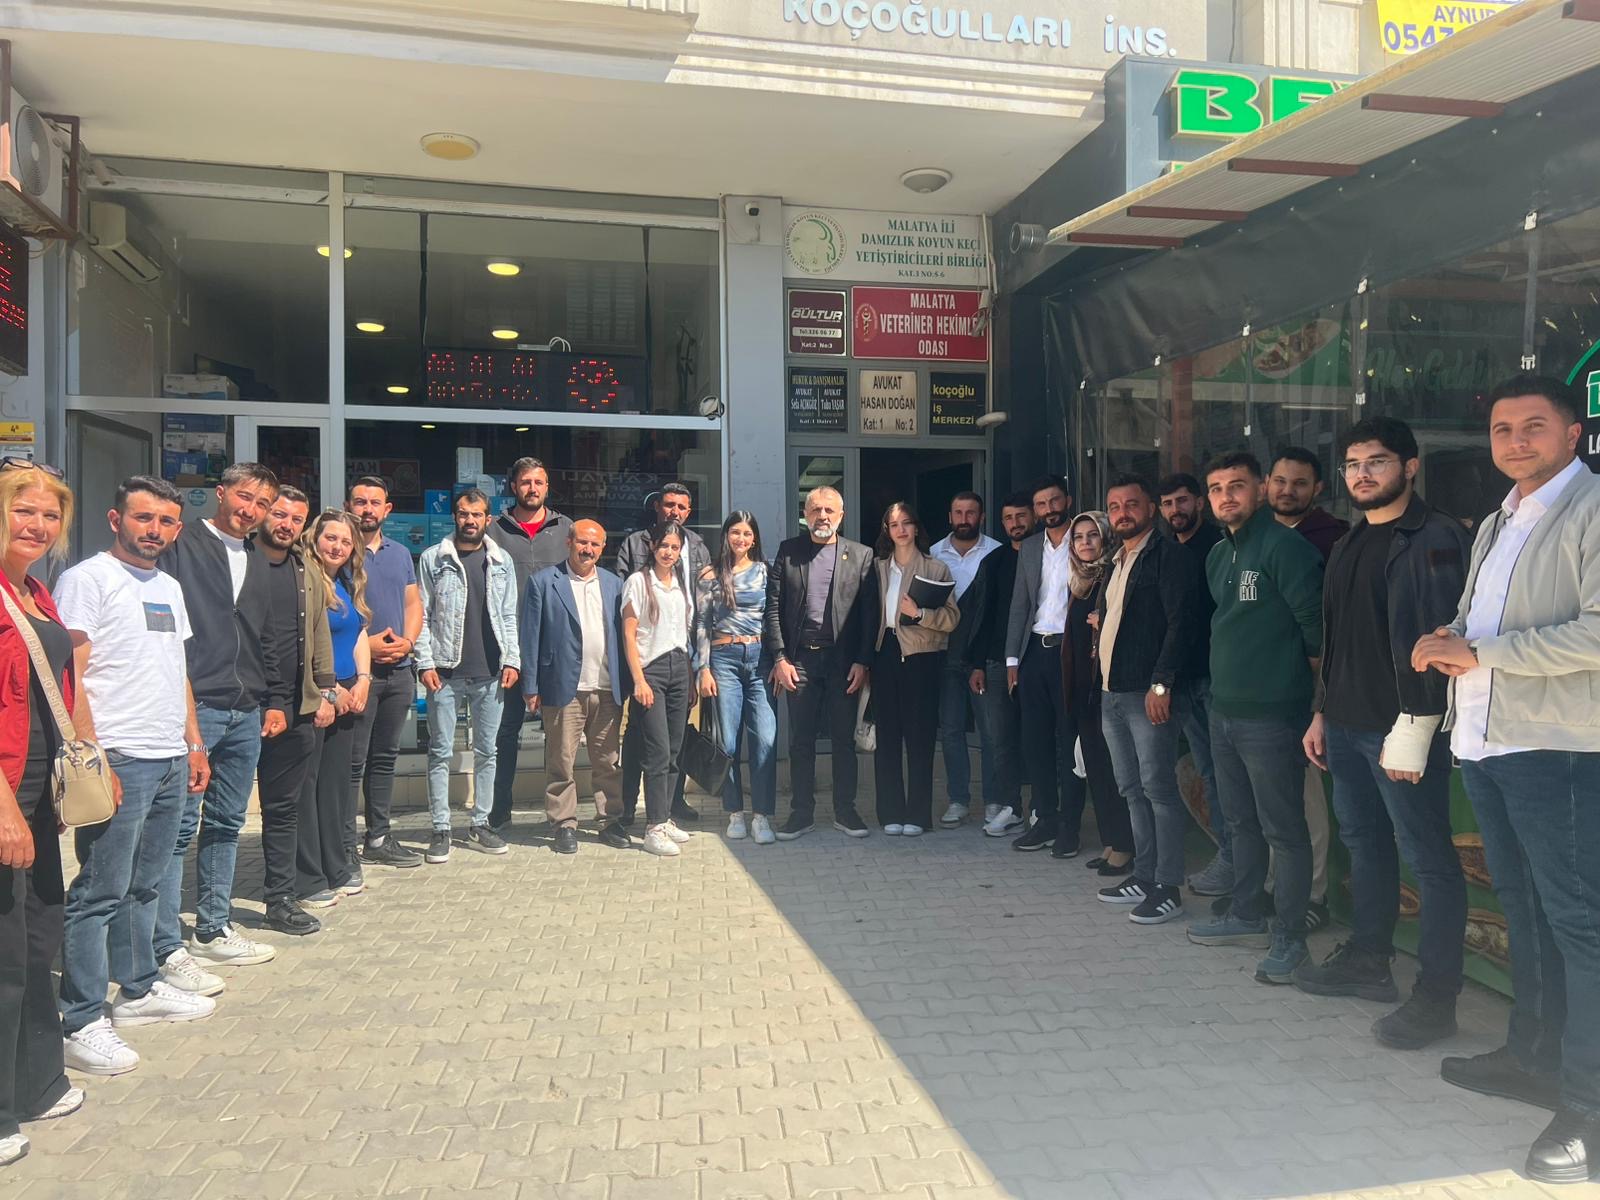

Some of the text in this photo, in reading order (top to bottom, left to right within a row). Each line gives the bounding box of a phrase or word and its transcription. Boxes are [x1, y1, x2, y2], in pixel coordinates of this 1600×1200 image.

[783, 0, 1072, 48] KOÇOĞULLARI
[888, 219, 955, 233] MALATYA İLİ
[861, 233, 915, 247] DAMIZLIK
[918, 236, 954, 249] KOYUN
[856, 249, 987, 268] YETİŞTİRİCİLERİ BİRLİĞİ
[910, 293, 956, 309] MALATYA
[791, 307, 843, 320] GÜLTUR
[880, 312, 933, 335] VETERİNER
[918, 339, 948, 356] ODASI
[873, 375, 902, 390] AVUKAT
[860, 395, 915, 410] HASAN DOĞAN
[863, 417, 884, 430] Kat: 1
[895, 418, 914, 431] No: 2
[932, 415, 975, 425] MERKEZİ
